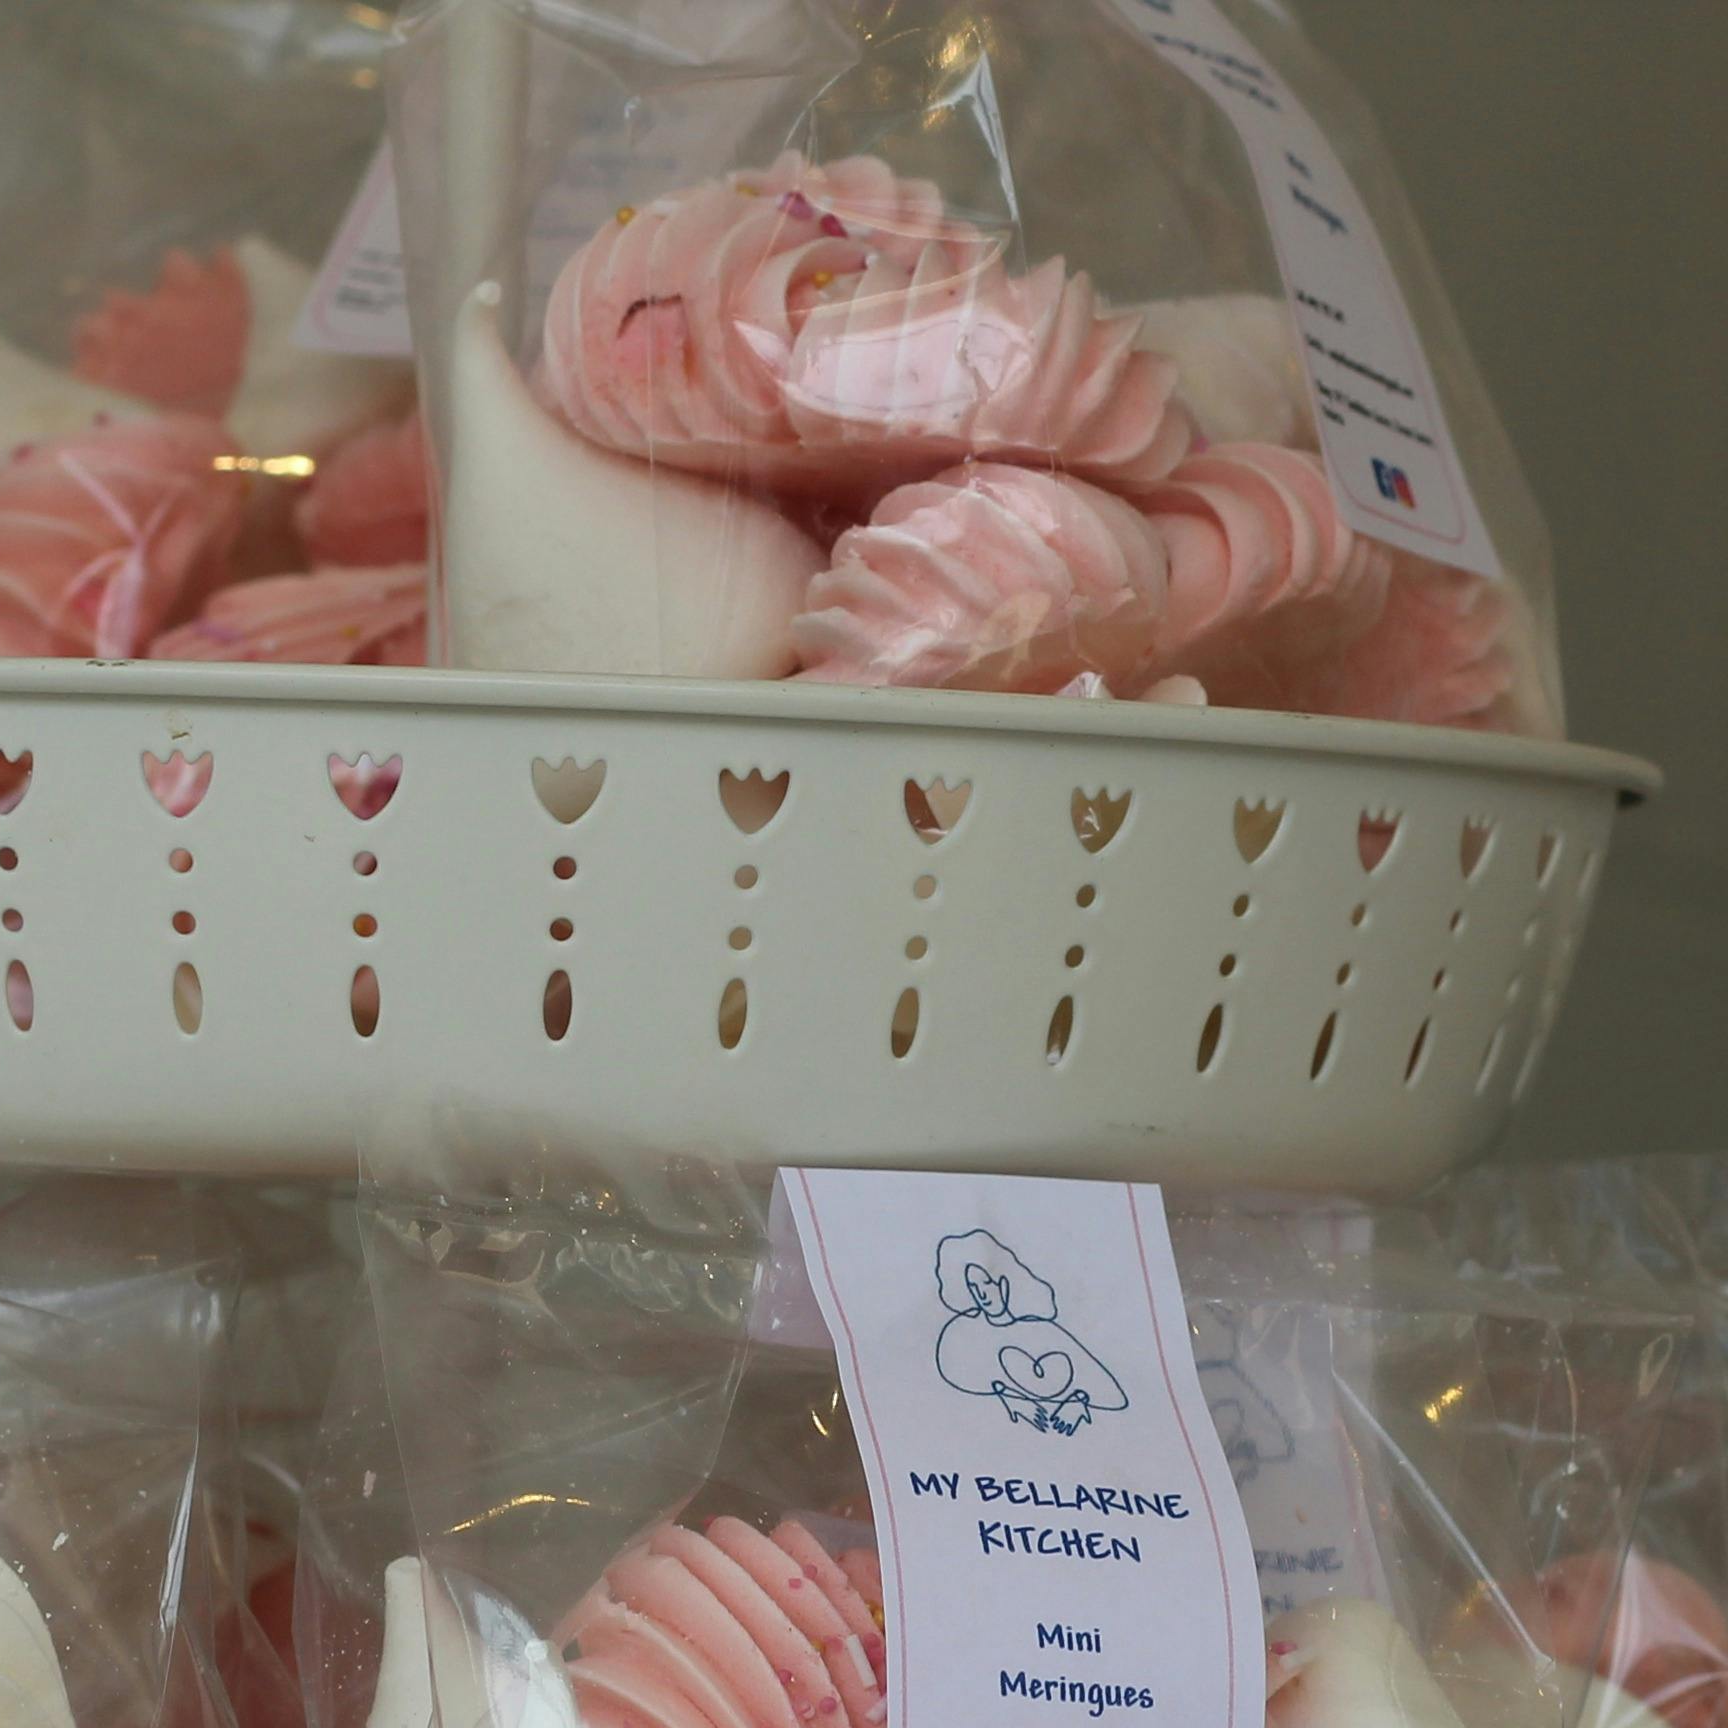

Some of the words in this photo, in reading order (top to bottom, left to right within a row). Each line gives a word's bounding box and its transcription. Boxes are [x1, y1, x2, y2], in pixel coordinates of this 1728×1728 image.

[909, 1472, 959, 1500] MY
[975, 1476, 1189, 1519] BELLARINE
[978, 1520, 1141, 1563] KITCHEN
[1037, 1623, 1101, 1653] Mini
[1000, 1670, 1154, 1717] Meringues
